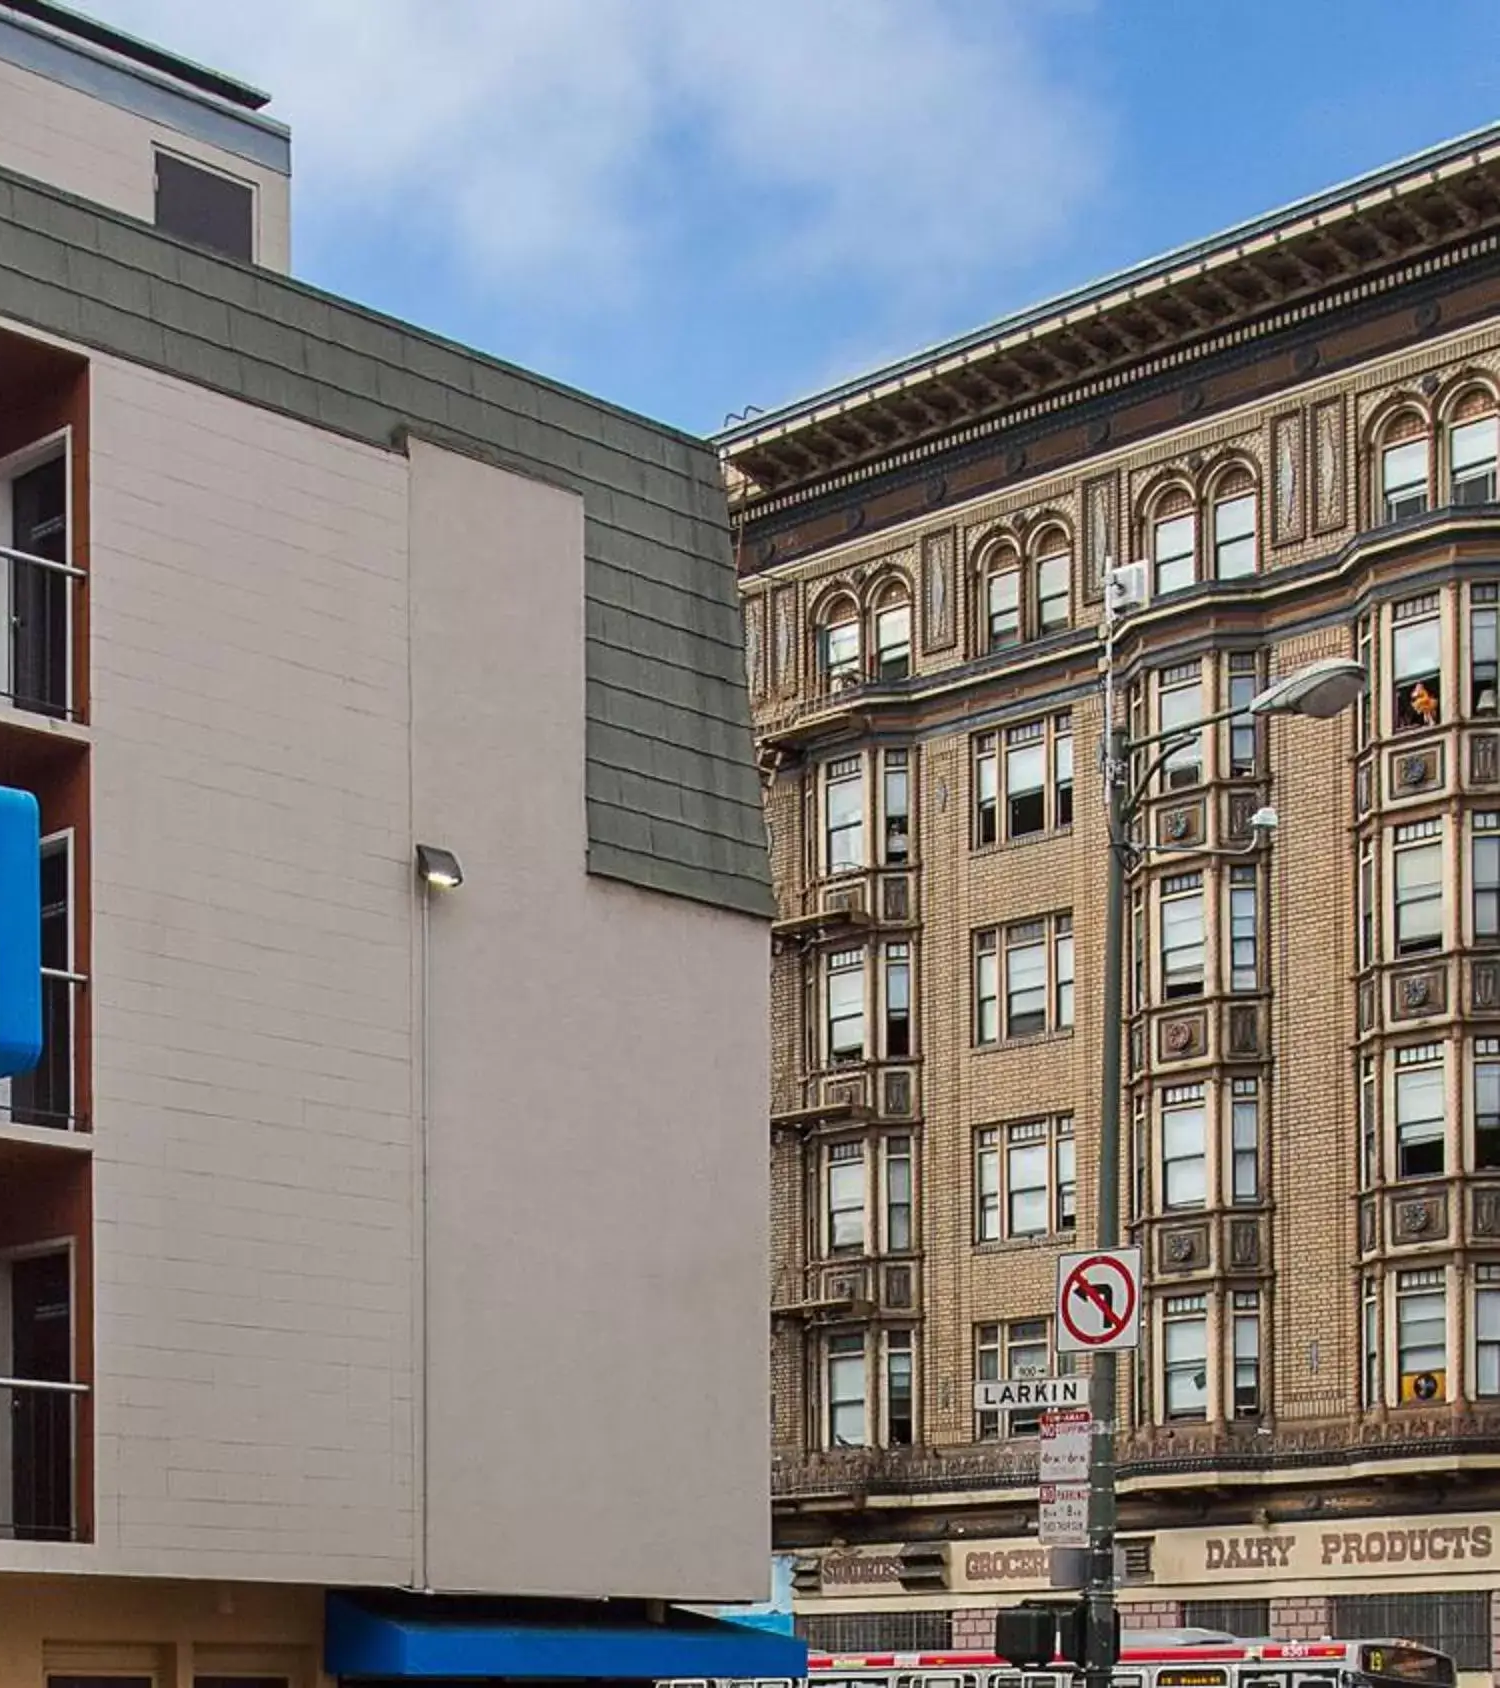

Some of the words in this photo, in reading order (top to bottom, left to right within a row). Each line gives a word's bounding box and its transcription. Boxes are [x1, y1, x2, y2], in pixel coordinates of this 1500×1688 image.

[984, 1382, 1077, 1404] LARKIN
[1205, 1535, 1296, 1569] DAIRY
[1320, 1525, 1492, 1564] PRODUCTS
[966, 1549, 1051, 1580] GROCER
